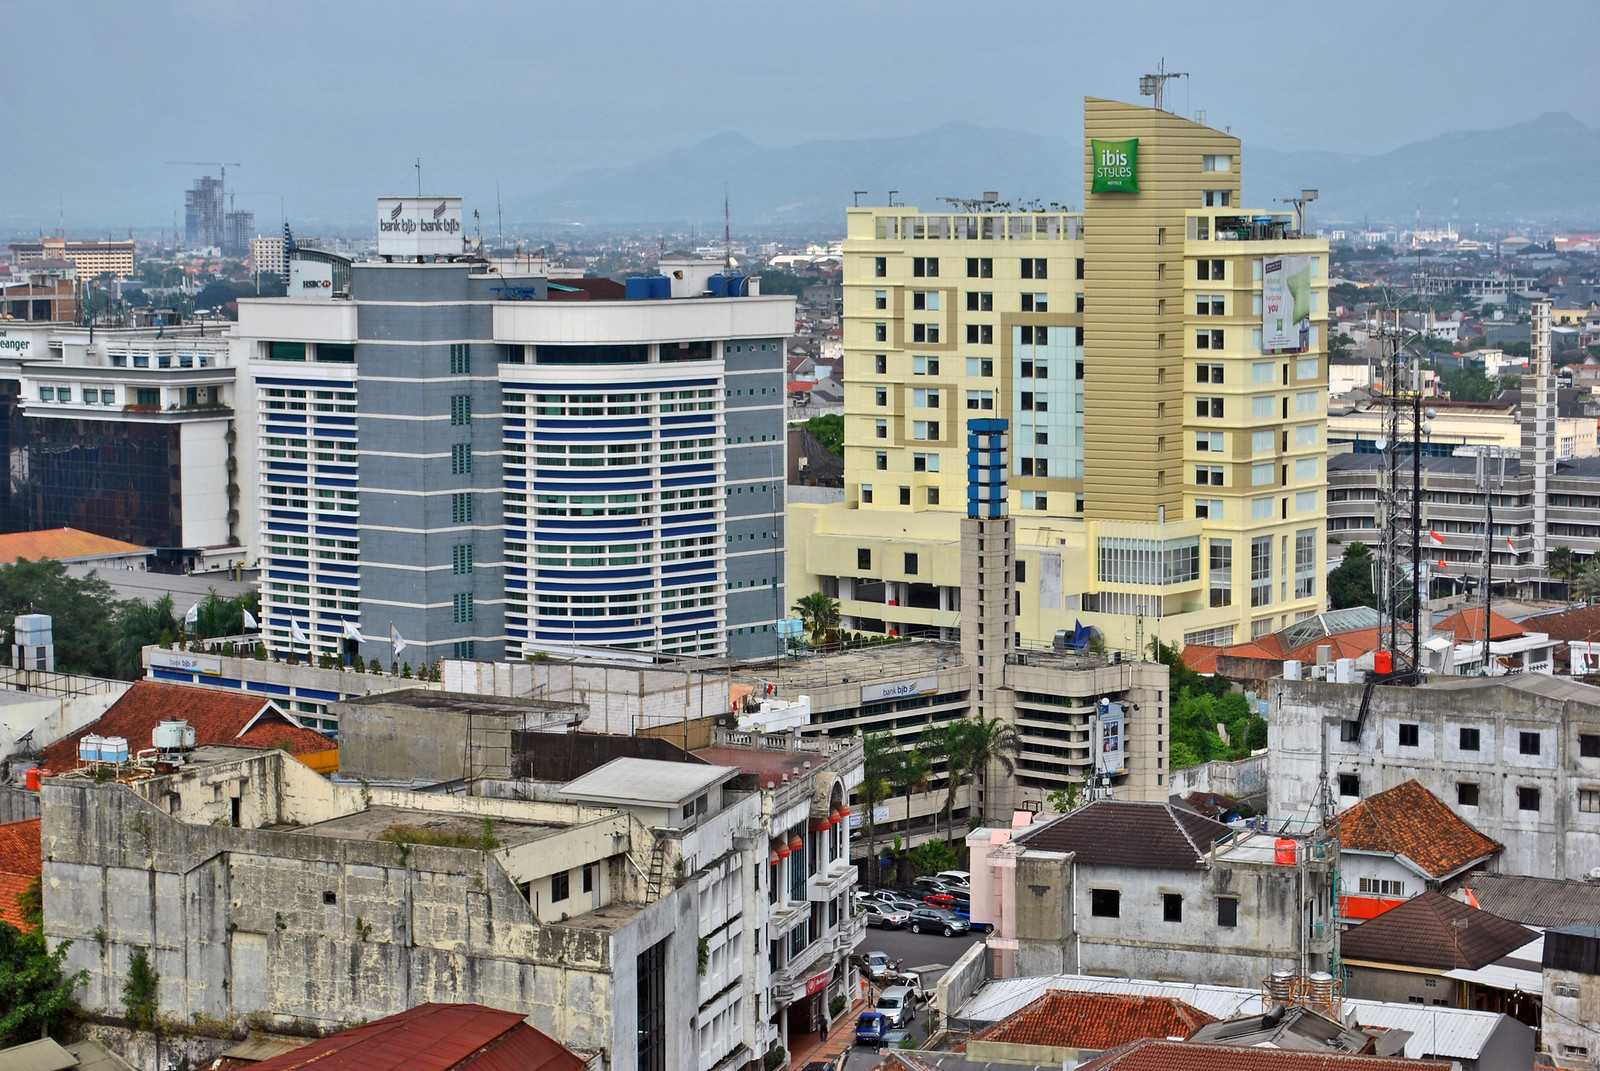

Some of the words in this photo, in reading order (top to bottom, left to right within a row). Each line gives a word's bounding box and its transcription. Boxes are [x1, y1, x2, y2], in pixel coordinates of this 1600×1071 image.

[1102, 149, 1127, 166] ibis
[380, 218, 401, 232] bank
[401, 218, 417, 235] bjb
[420, 218, 443, 232] bank
[444, 218, 460, 235] bjb
[303, 280, 321, 288] HSBC
[1268, 304, 1279, 314] you
[882, 687, 897, 697] bank
[897, 685, 908, 695] bjb
